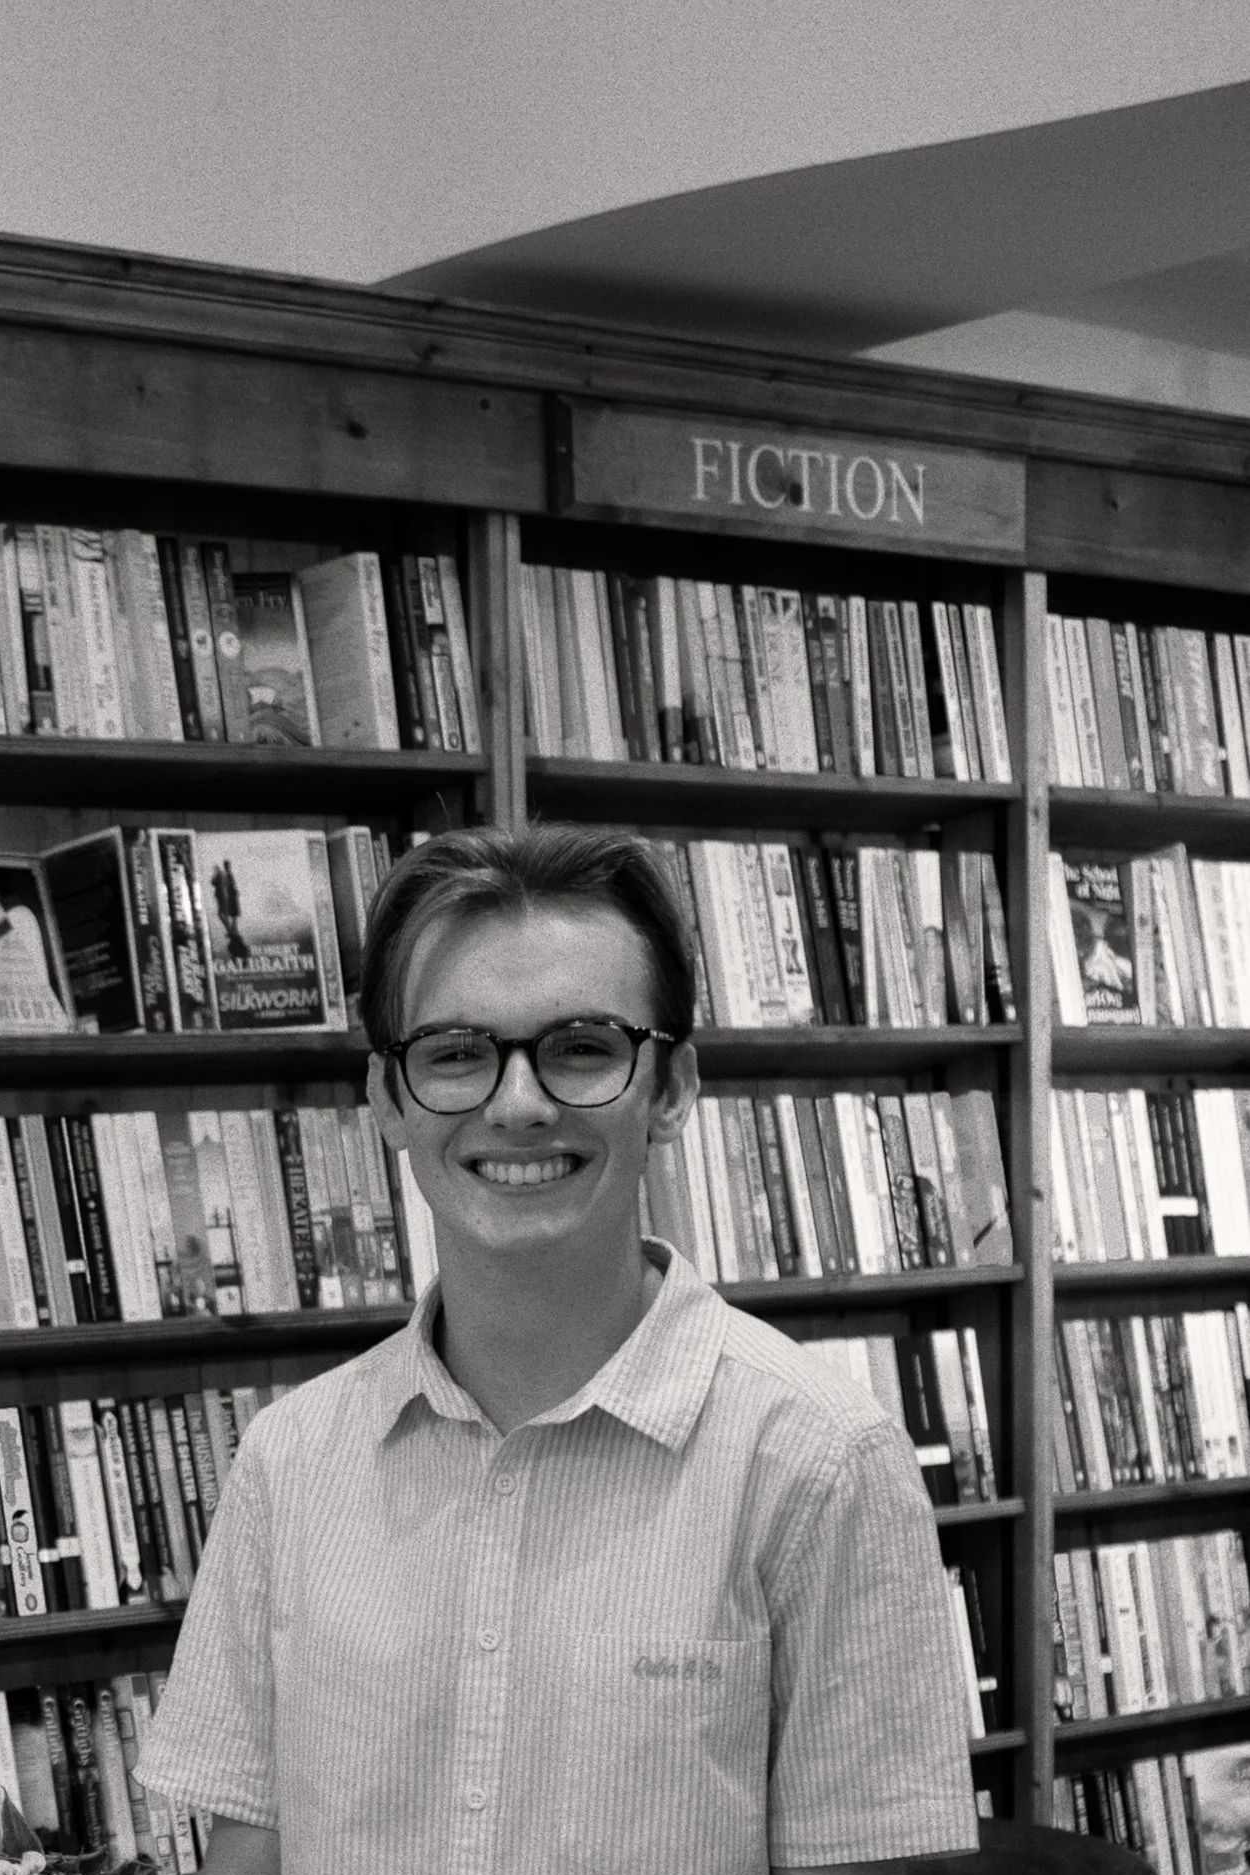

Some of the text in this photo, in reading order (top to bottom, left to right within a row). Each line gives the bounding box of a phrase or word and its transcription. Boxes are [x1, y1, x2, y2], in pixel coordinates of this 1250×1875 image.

[690, 436, 929, 527] FICTION
[213, 953, 316, 974] GALBRAITH
[250, 943, 301, 957] ROBERT
[218, 988, 320, 1013] SILKWORM
[290, 1167, 311, 1242] HEKATE
[171, 1408, 198, 1503] TIME SHELTER
[193, 1434, 216, 1511] HUSBANDS
[42, 1696, 61, 1766] Griffiths
[71, 1698, 94, 1766] Griffiths
